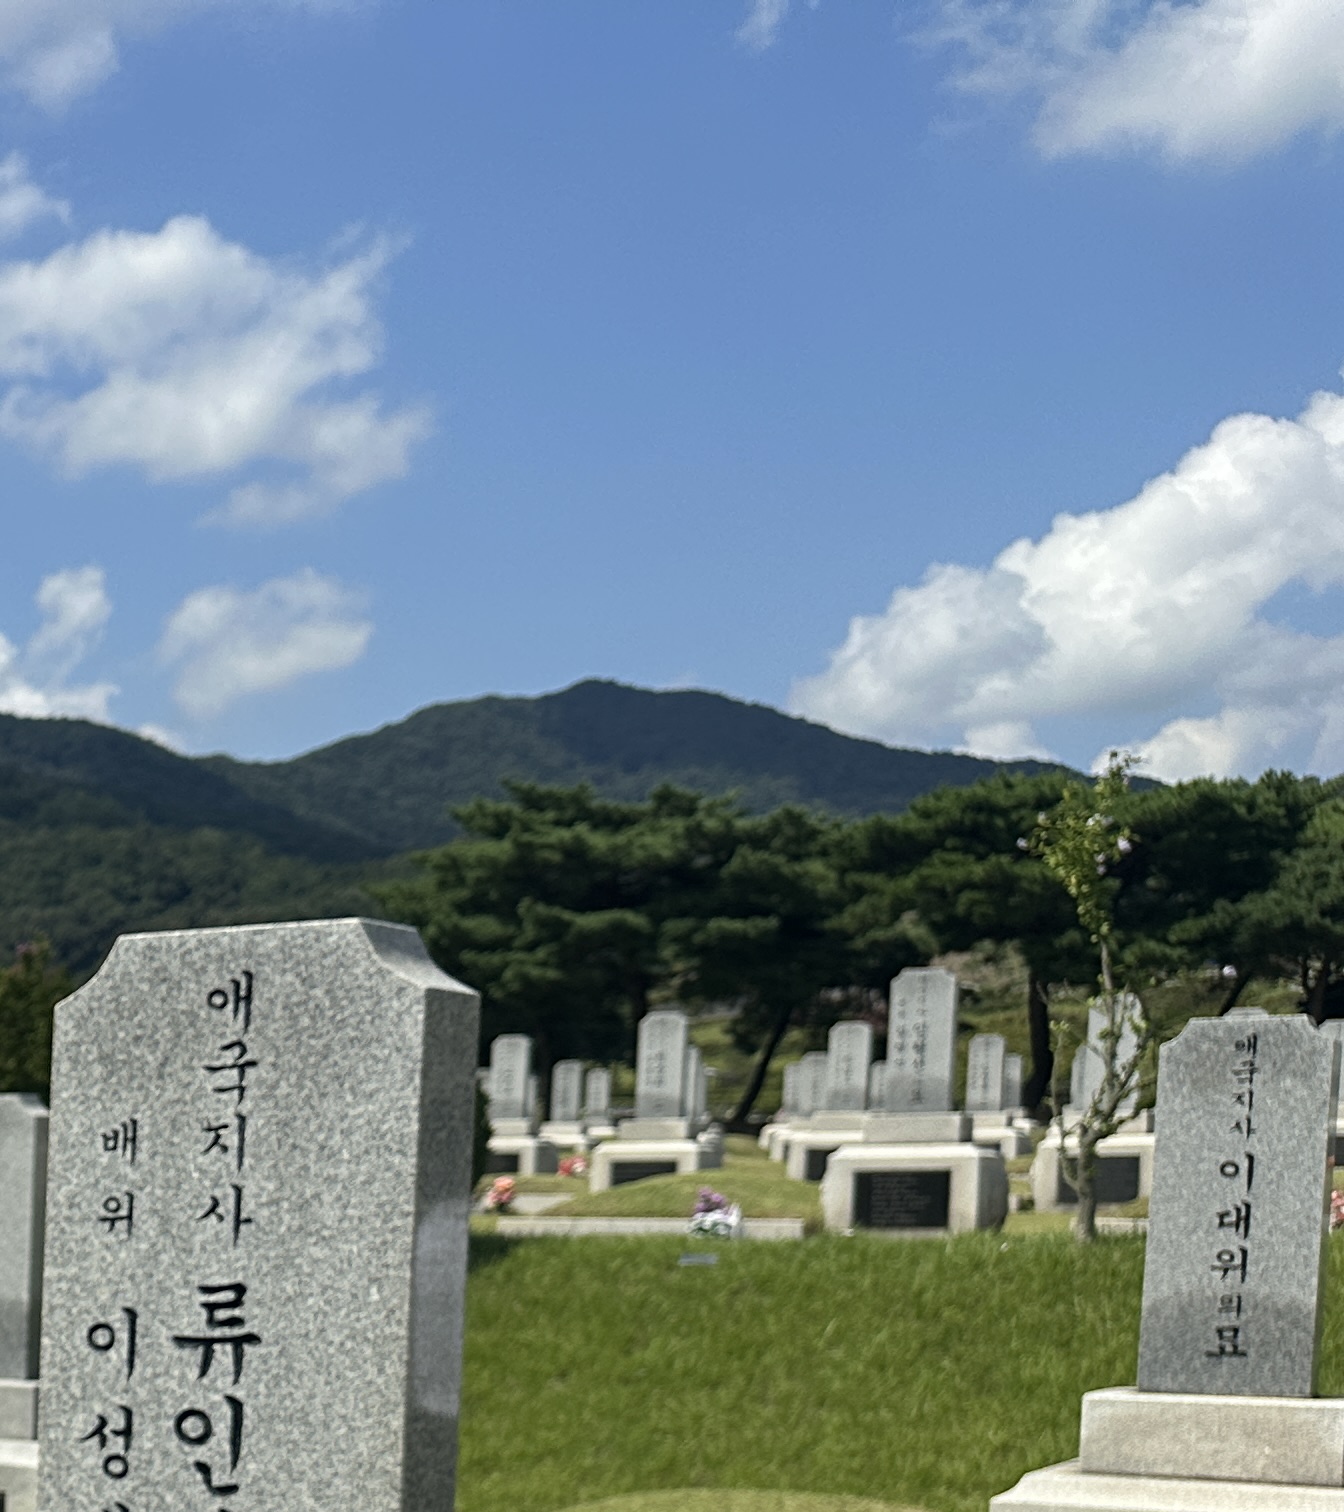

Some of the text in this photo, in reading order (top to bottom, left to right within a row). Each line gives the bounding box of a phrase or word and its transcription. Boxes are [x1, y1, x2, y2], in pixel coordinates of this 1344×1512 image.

[201, 970, 258, 1245] 애국지사
[1231, 1032, 1258, 1139] 애국지사
[99, 1119, 137, 1234] 배위
